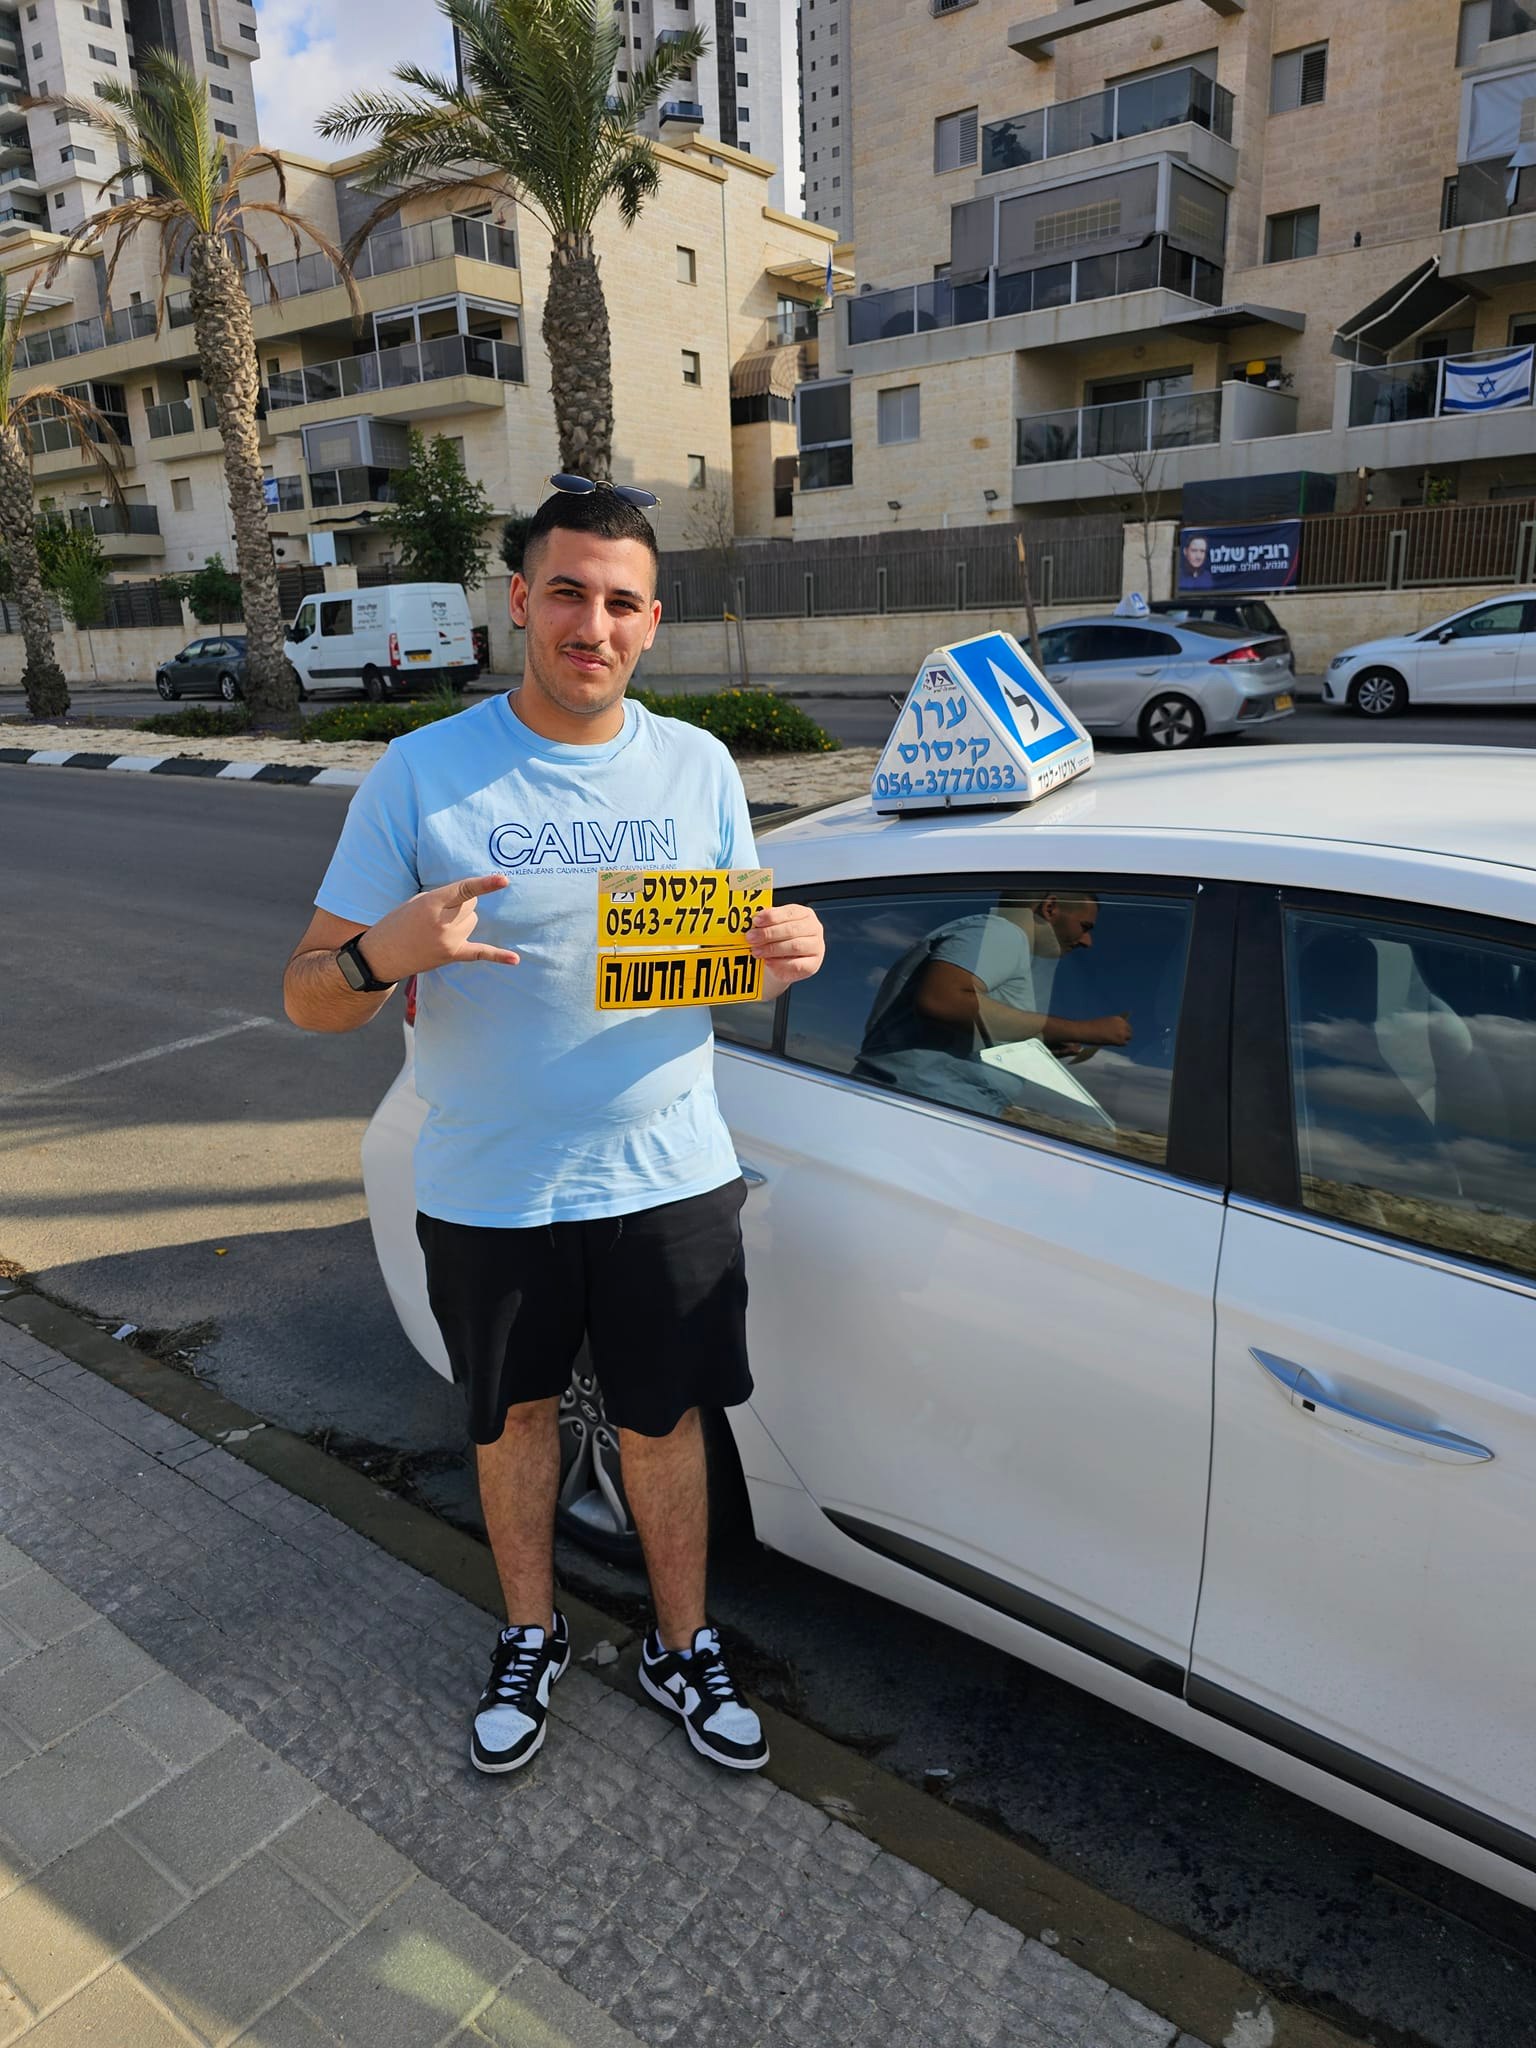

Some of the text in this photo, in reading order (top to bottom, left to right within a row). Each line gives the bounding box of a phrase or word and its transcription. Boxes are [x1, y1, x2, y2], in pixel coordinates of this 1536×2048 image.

[1248, 543, 1289, 563] רוביק
[909, 695, 968, 739] ערן
[1003, 686, 1039, 731] ל
[897, 736, 991, 766] קיסוס
[876, 764, 1016, 796] 054-3777033
[489, 818, 678, 868] CALVIN
[642, 875, 717, 910] קיסוס
[606, 906, 764, 936] 0543-777-03
[604, 954, 757, 1003] נהג/ת חדש/ה
